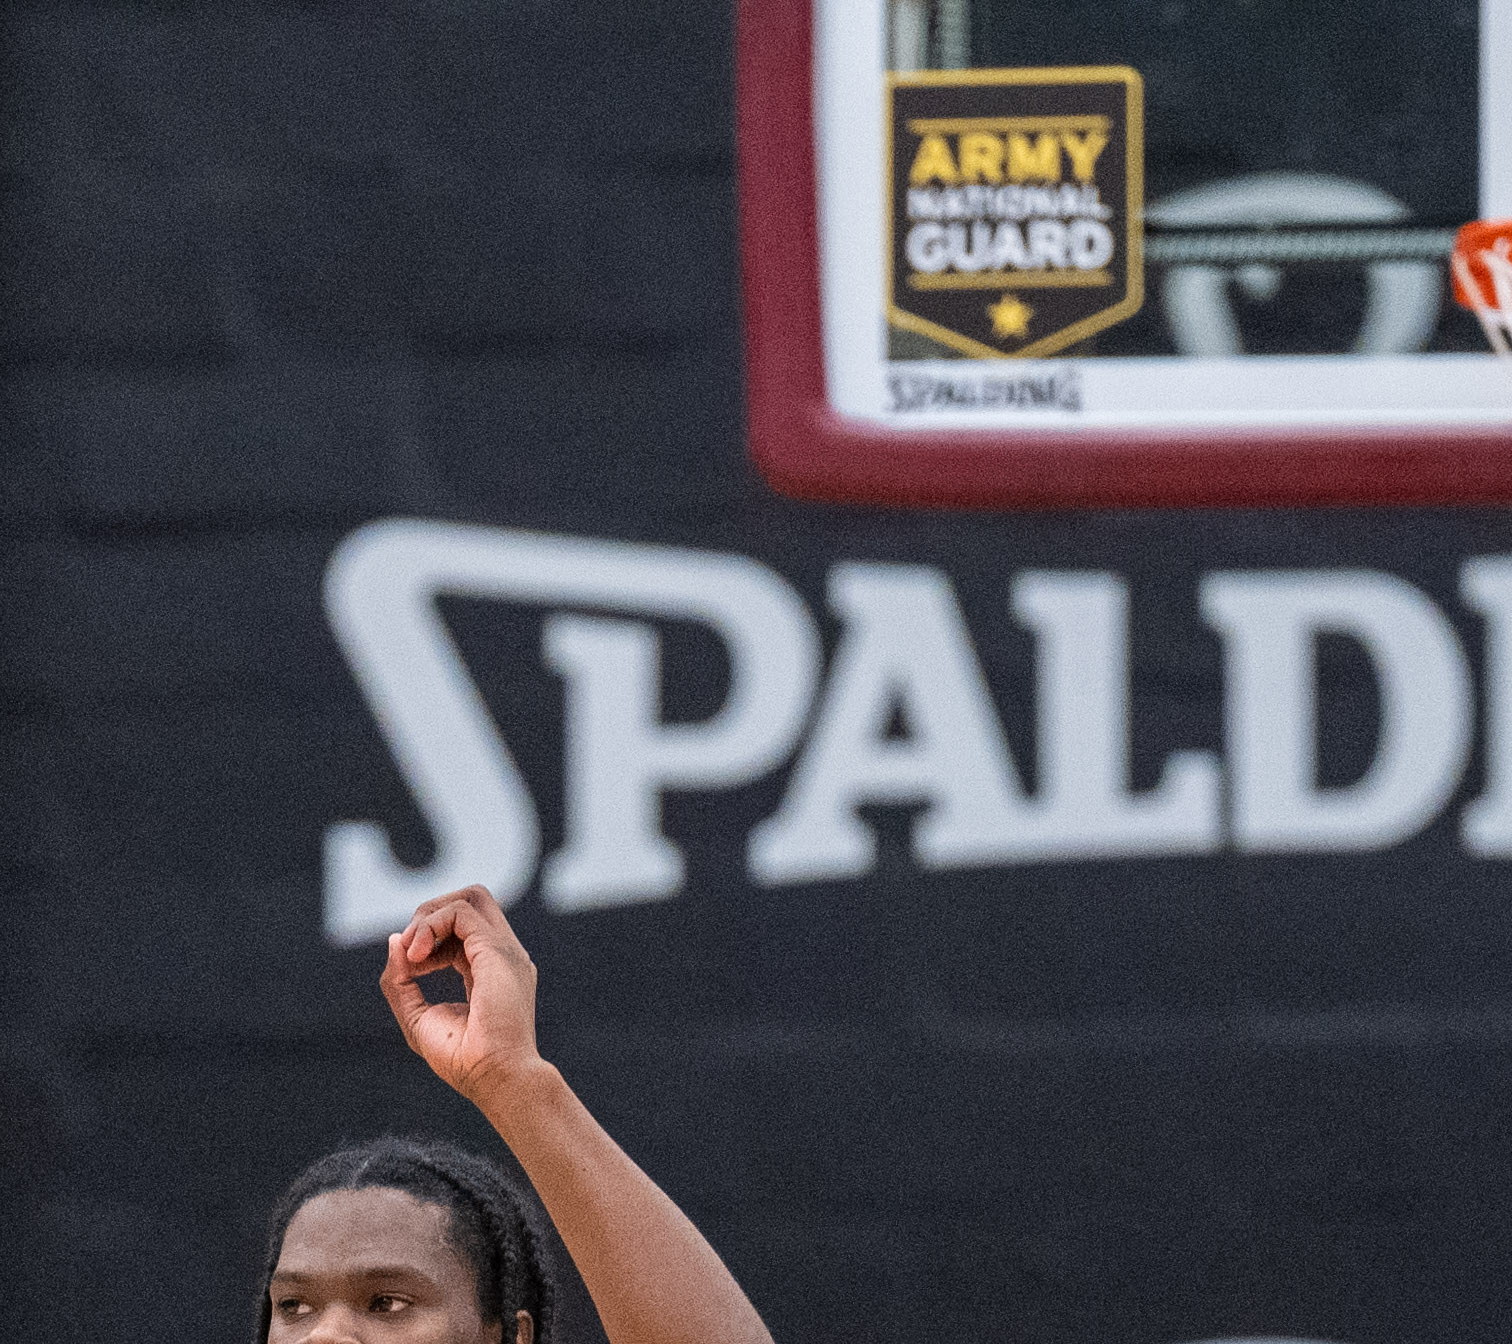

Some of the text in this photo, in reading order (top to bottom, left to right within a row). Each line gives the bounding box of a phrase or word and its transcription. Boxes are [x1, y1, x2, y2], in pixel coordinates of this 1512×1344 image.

[909, 130, 1109, 185] ARMY
[906, 184, 1113, 222] NATIONAL
[905, 219, 1115, 275] GUARD
